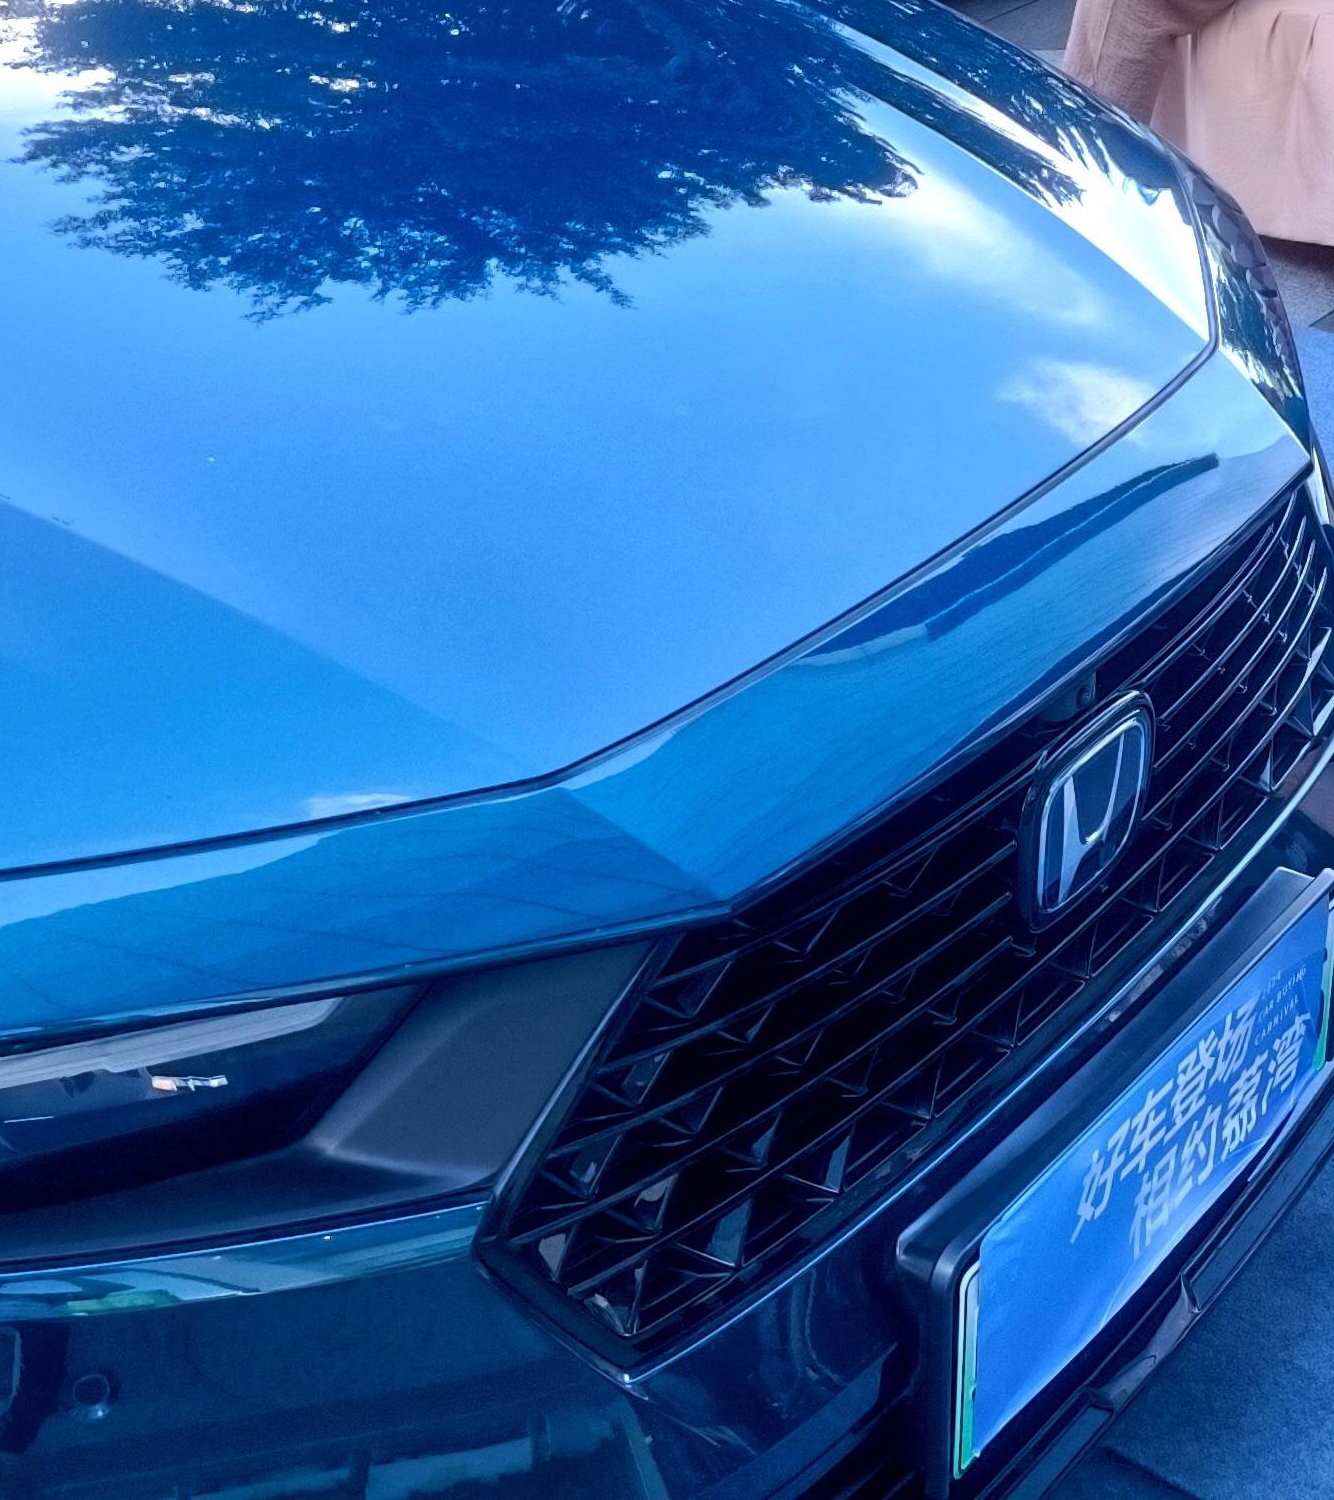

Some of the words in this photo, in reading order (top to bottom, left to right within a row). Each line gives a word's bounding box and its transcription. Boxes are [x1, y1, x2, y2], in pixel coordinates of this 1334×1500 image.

[1070, 992, 1260, 1245] 好车登场
[1129, 1012, 1312, 1262] 相约荔湾
